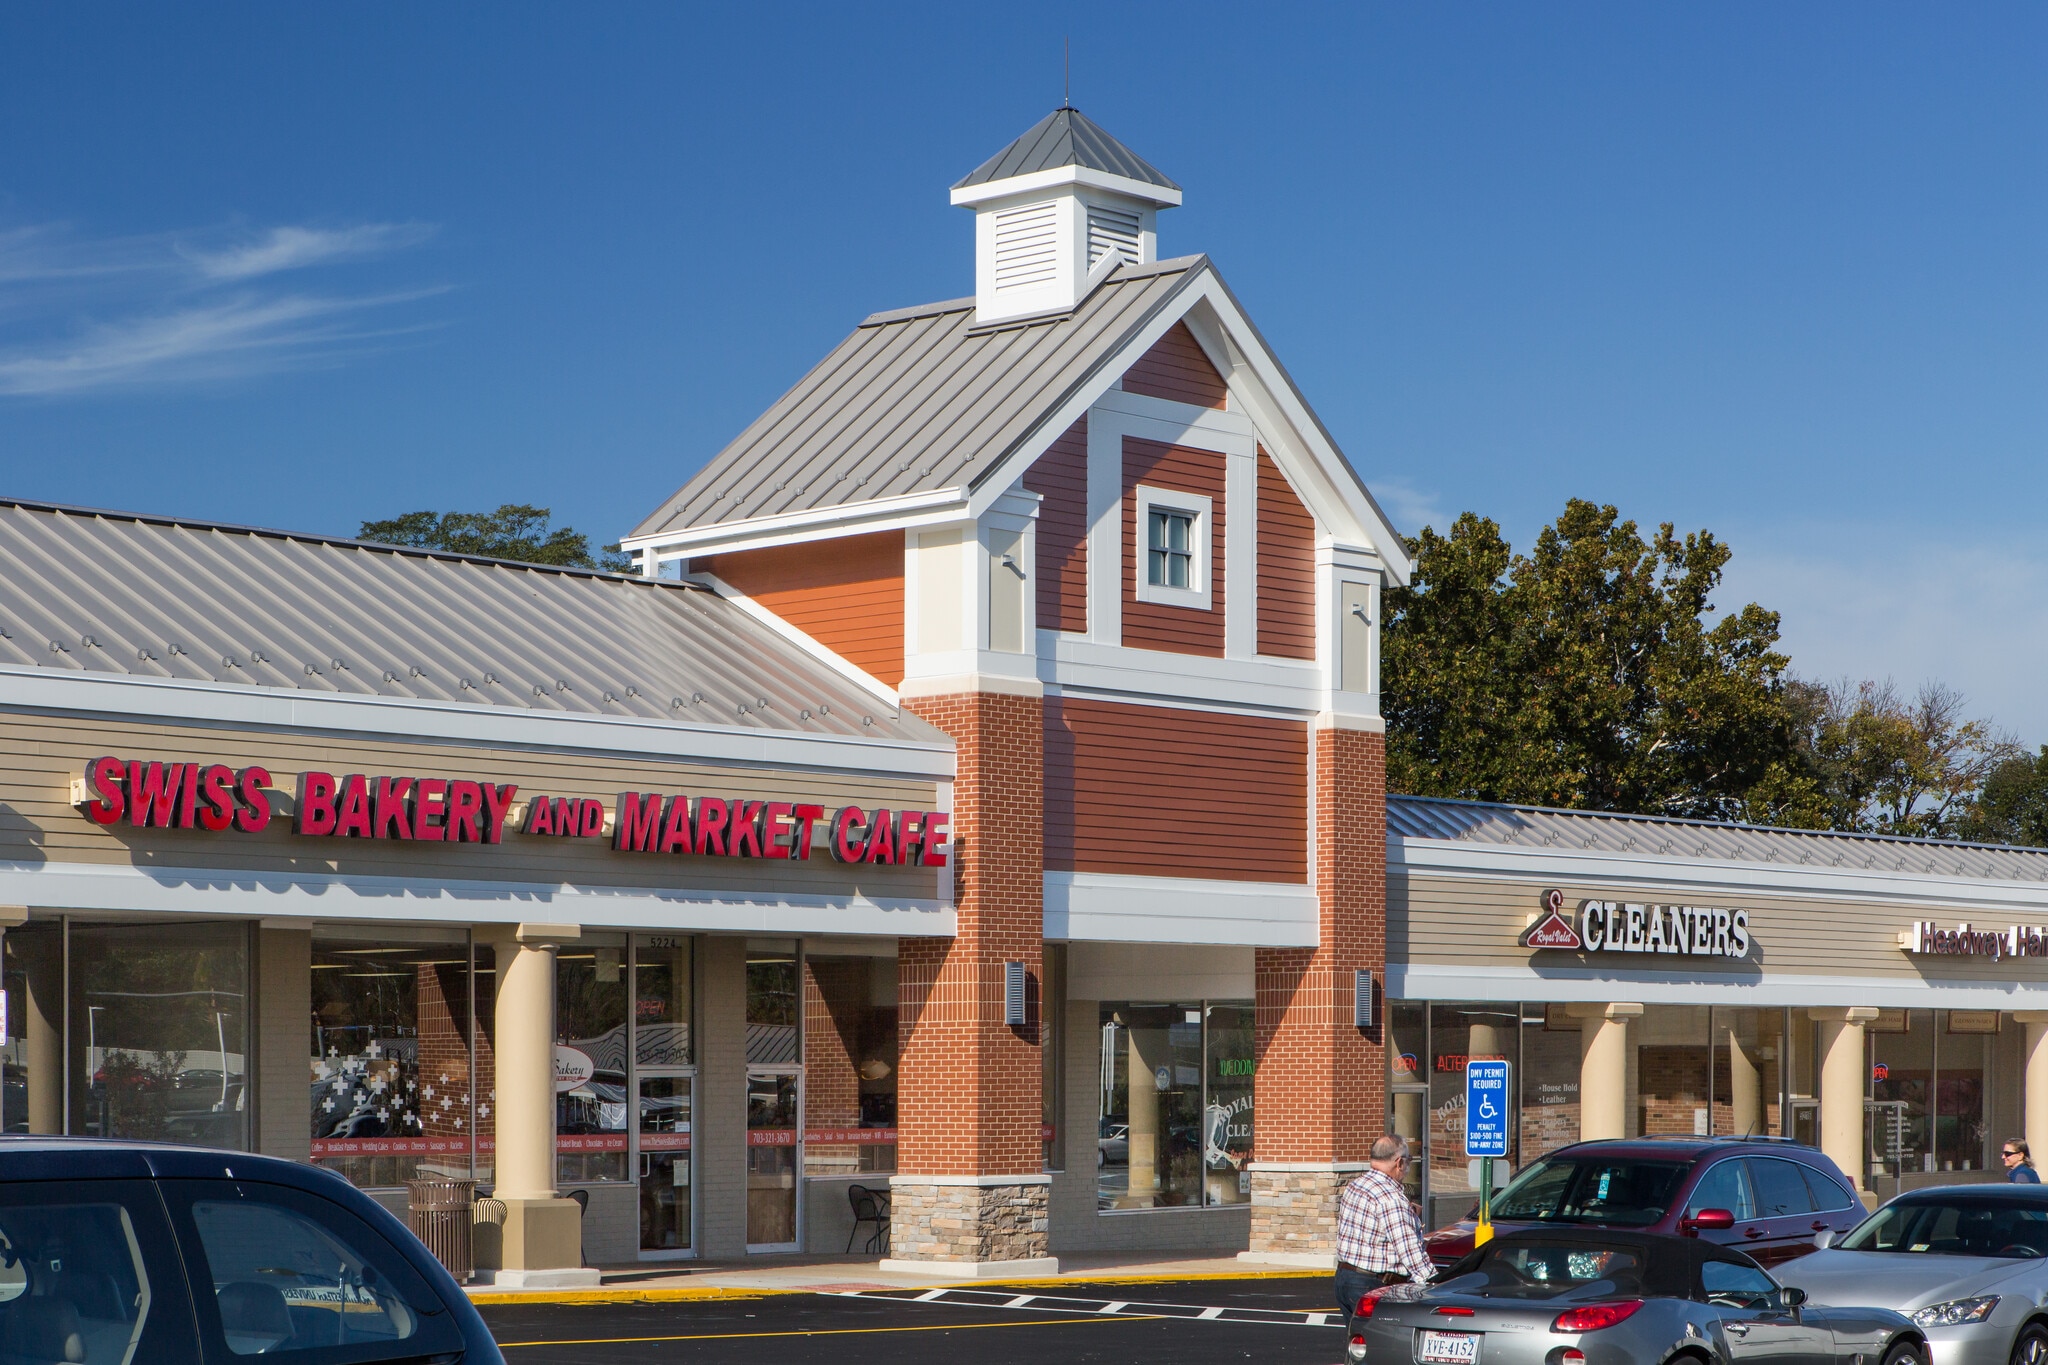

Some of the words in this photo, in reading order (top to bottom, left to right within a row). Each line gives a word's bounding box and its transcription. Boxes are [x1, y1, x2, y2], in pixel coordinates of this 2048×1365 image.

[86, 756, 273, 834] SWISS
[295, 771, 518, 844] BAKERY
[522, 796, 604, 838] AND
[613, 792, 824, 860] MARKET
[830, 806, 949, 867] CAFE
[1580, 900, 1749, 958] CLEANERS
[1537, 929, 1555, 945] Royal
[1555, 929, 1571, 943] Valet
[1918, 921, 2009, 961] Headway
[650, 938, 676, 949] 5224
[635, 1001, 665, 1014] OPEN
[1220, 1059, 1255, 1076] WEDDIN
[1391, 1058, 1417, 1070] OPEN
[1470, 1068, 1482, 1078] DMV
[1484, 1068, 1504, 1078] PERMIT
[1473, 1080, 1502, 1089] REQUIRED
[1542, 1084, 1561, 1092] House
[1563, 1083, 1578, 1092] Hold
[1542, 1095, 1566, 1103] Leather
[1436, 1093, 1466, 1121] ROYA
[753, 1133, 790, 1143] 703-321-3670
[804, 1132, 821, 1141] andwiches
[1470, 1132, 1492, 1140] $100-500
[1493, 1132, 1503, 1140] FINE
[311, 1142, 324, 1152] Coffee
[361, 1142, 378, 1152] Wedding
[378, 1142, 389, 1151] Cakes
[392, 1142, 407, 1151] Cookies
[1492, 1141, 1503, 1149] ZONE
[1425, 1339, 1474, 1357] XVE-4152
